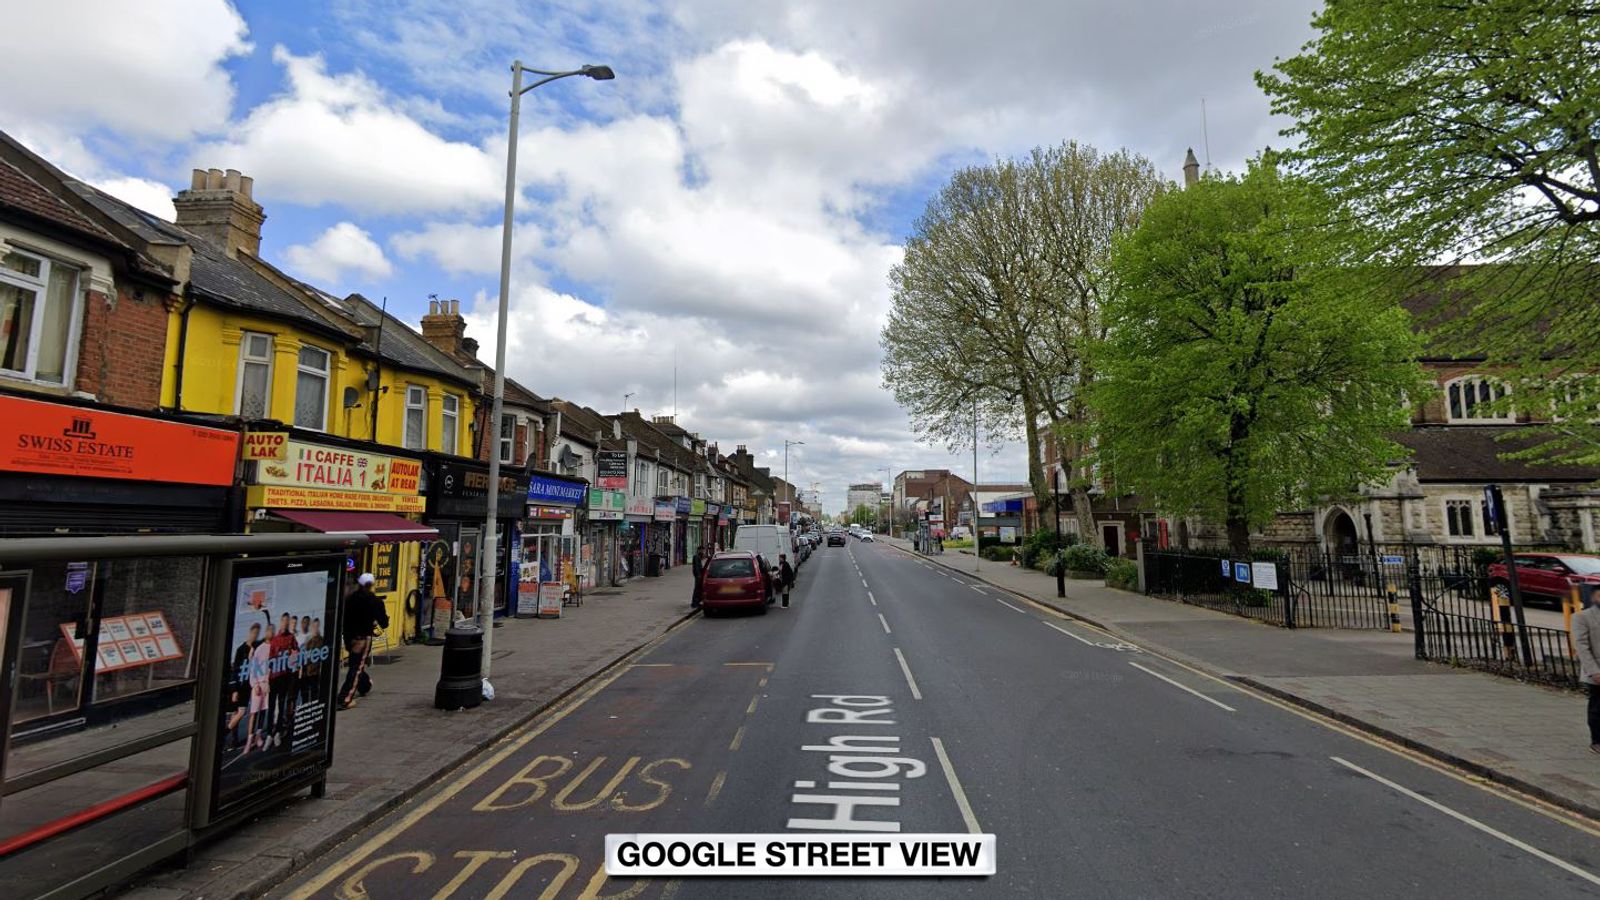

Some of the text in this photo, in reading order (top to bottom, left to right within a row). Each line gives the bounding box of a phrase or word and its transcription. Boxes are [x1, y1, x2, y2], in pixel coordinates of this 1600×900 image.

[18, 434, 135, 458] SWISS ESTATE
[246, 434, 284, 446] AUTO
[250, 447, 277, 457] LAK
[315, 450, 354, 467] CAFFE
[296, 463, 366, 487] ITALIA 1
[391, 462, 419, 477] AUTOLAK
[391, 478, 417, 490] AT REAR
[559, 487, 582, 499] MARKET
[471, 755, 693, 812] BUS
